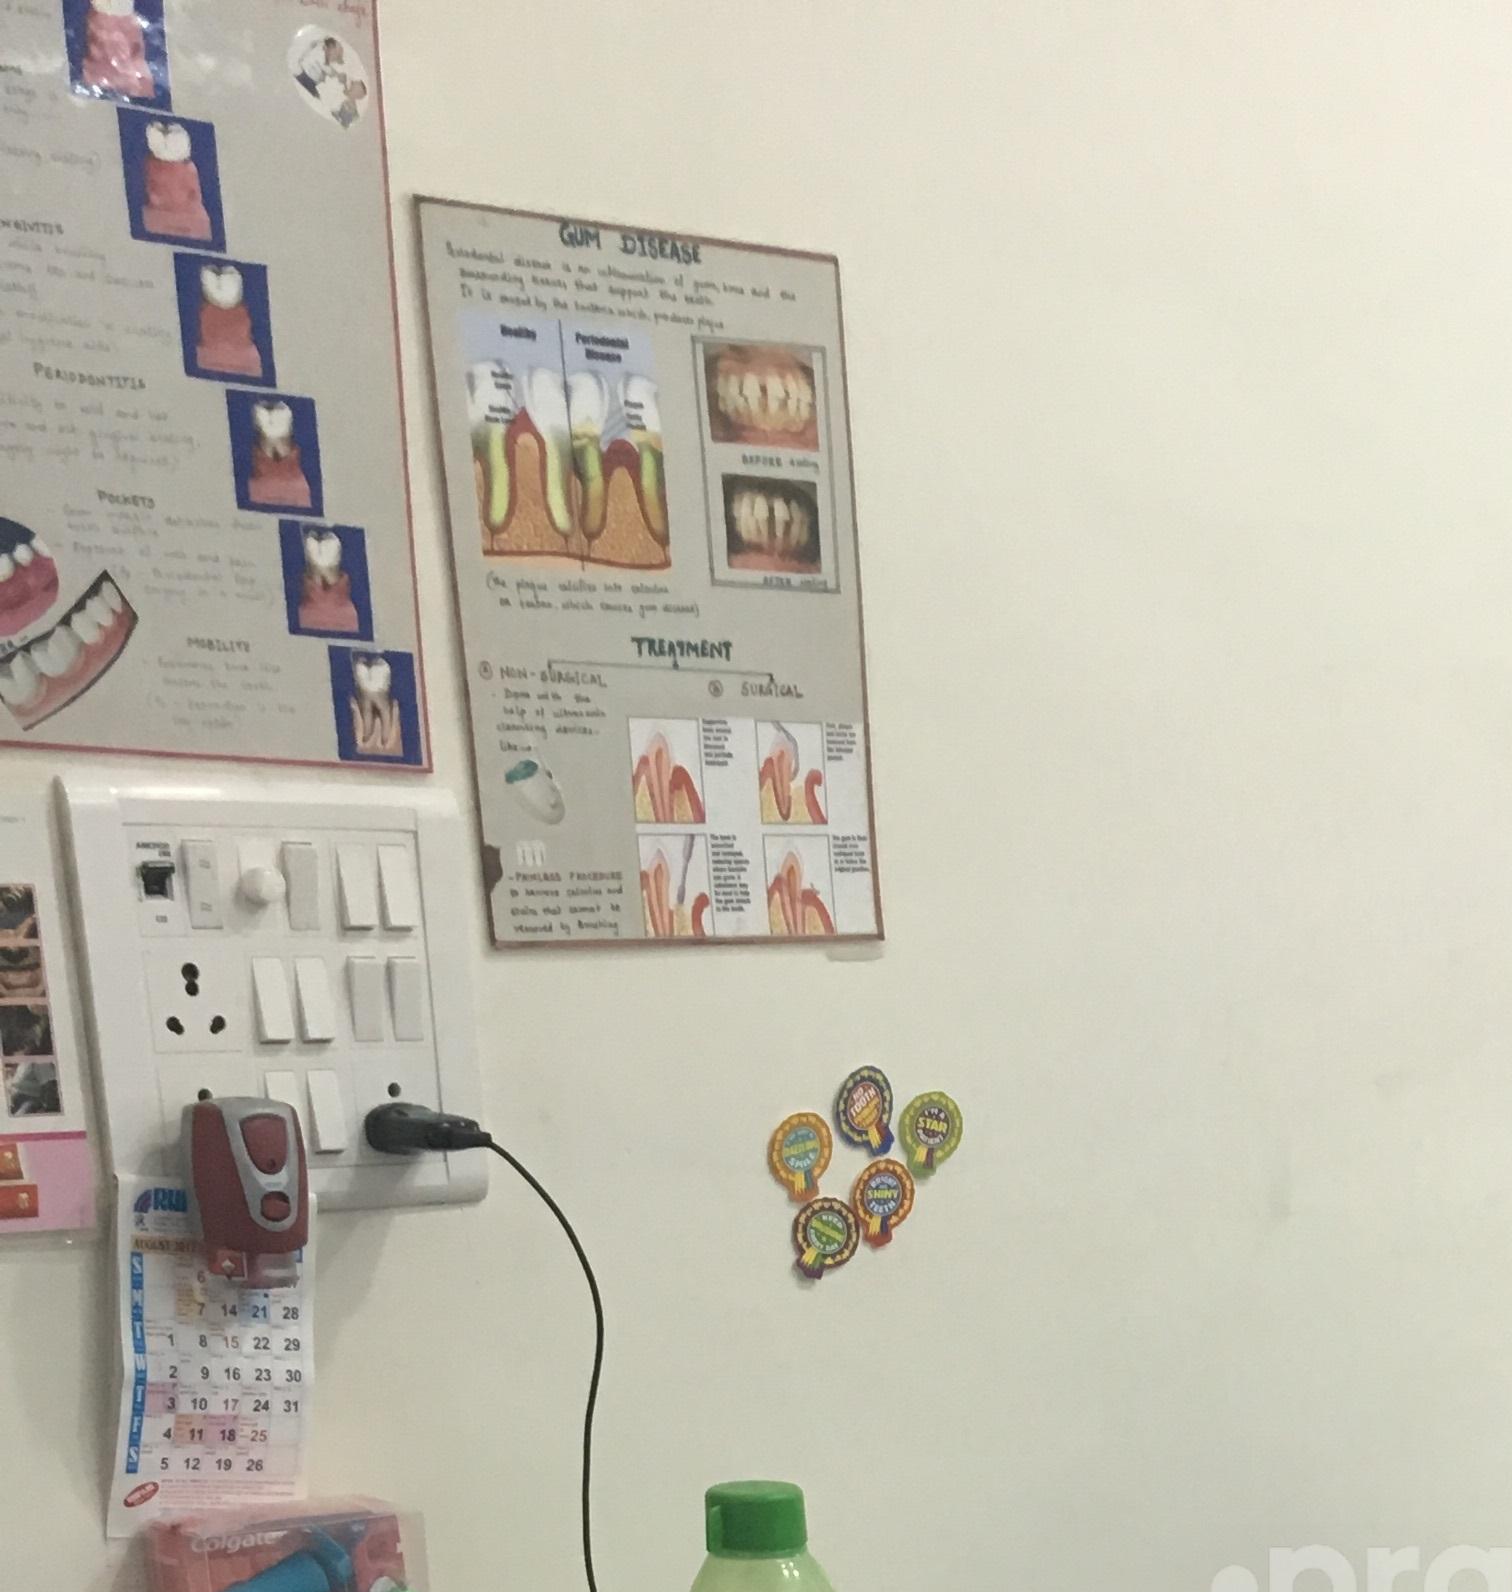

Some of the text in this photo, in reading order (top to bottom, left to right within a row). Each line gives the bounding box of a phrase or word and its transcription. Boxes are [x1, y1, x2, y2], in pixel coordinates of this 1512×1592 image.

[559, 219, 702, 266] GUM DISEASE
[575, 332, 630, 350] Periodontal
[33, 361, 147, 390] PERIODONTITIS
[631, 636, 733, 662] TREATMENT
[741, 682, 803, 699] SURGICAL
[850, 1087, 876, 1117] TOOTH
[918, 1117, 948, 1134] STAR
[866, 1189, 898, 1200] SHINY
[869, 1200, 897, 1213] TEETH
[196, 1302, 205, 1315] 7
[221, 1303, 238, 1317] 14
[251, 1305, 268, 1318] 21
[282, 1306, 299, 1320] 28
[166, 1334, 174, 1346] 1
[199, 1334, 208, 1348] 8
[223, 1336, 240, 1349] 15
[253, 1337, 271, 1350] 22
[284, 1338, 301, 1352] 29
[168, 1366, 178, 1379] 2
[200, 1366, 210, 1380] 9
[224, 1367, 241, 1381] 16
[254, 1368, 272, 1382] 23
[285, 1369, 302, 1383] 30
[167, 1397, 176, 1410] 3
[191, 1397, 208, 1410] 10
[223, 1398, 239, 1411] 17
[252, 1399, 270, 1412] 24
[283, 1399, 299, 1413] 31
[162, 1427, 172, 1440] 4
[189, 1428, 204, 1441] 11
[220, 1429, 236, 1442] 18
[250, 1429, 268, 1442] 25
[160, 1457, 169, 1470] 5
[183, 1457, 200, 1470] 12
[215, 1458, 232, 1471] 19
[245, 1458, 263, 1472] 26
[191, 1530, 290, 1554] Colgate
